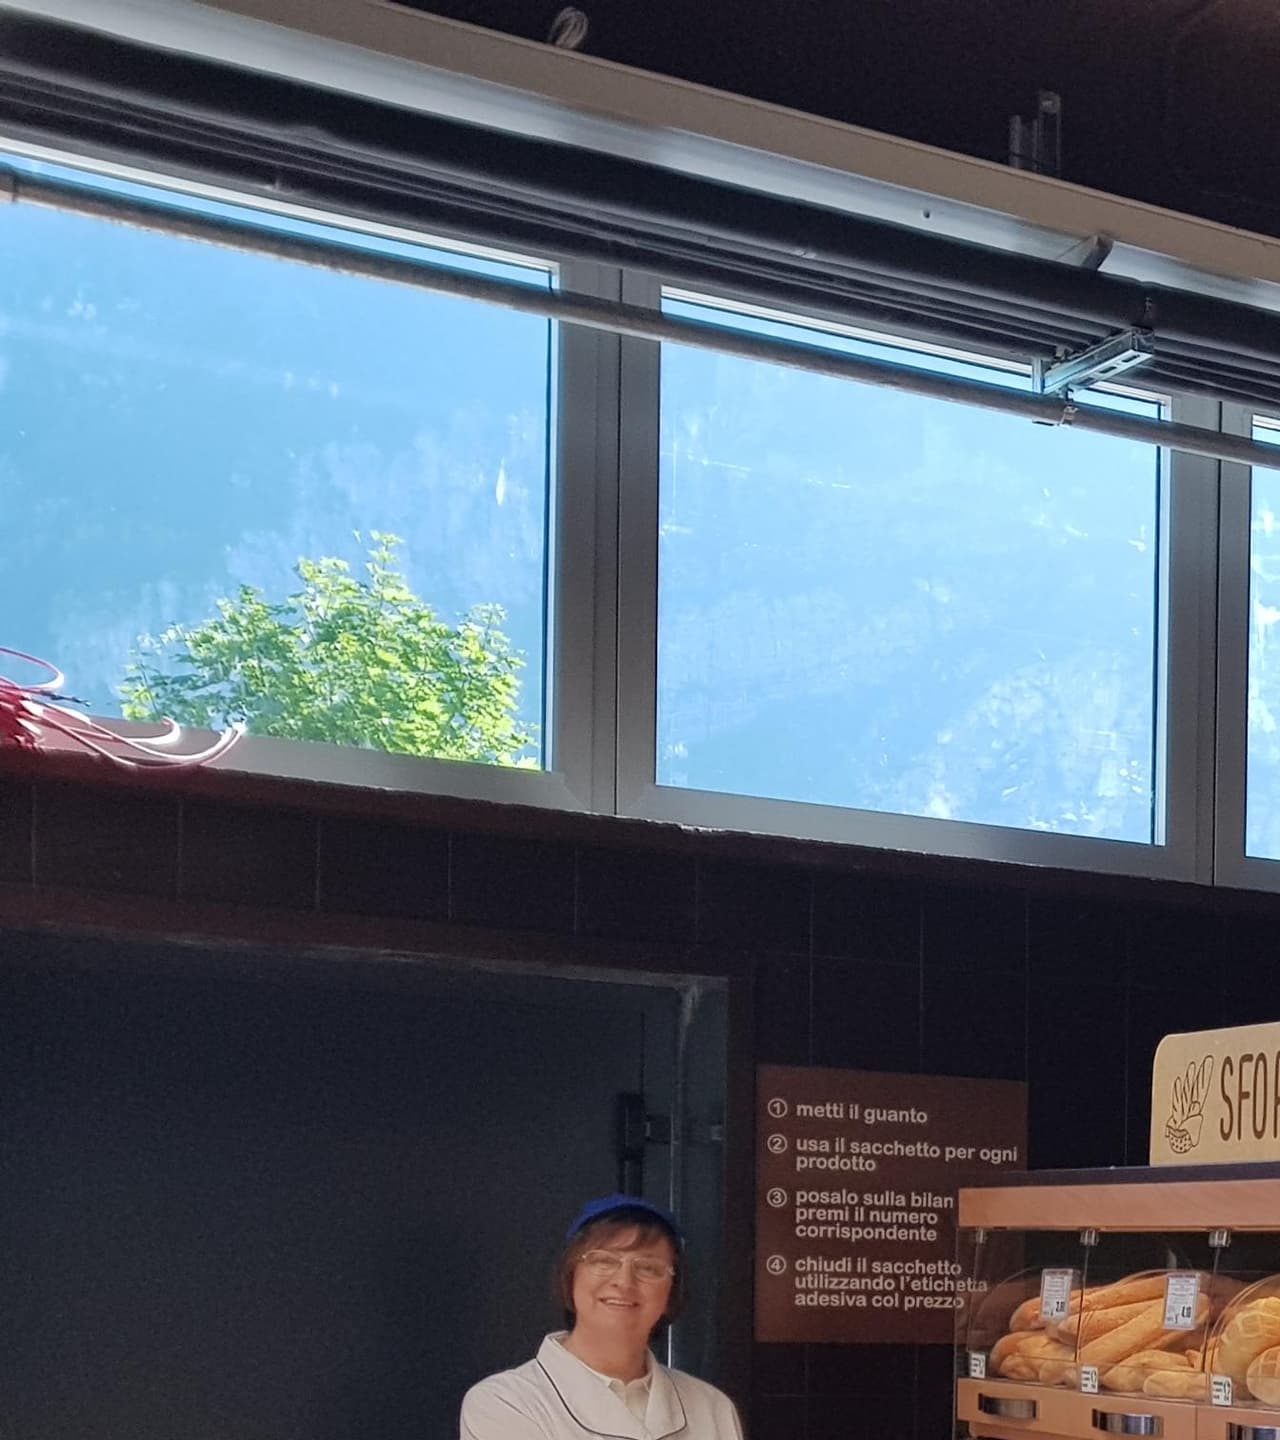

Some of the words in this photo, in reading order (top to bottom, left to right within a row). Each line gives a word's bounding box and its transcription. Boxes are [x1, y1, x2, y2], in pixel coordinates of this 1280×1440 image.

[797, 1102, 843, 1118] metti
[849, 1104, 859, 1119] il
[864, 1107, 928, 1124] guanto
[796, 1138, 829, 1152] usa
[835, 1138, 845, 1152] il
[850, 1141, 940, 1158] sacchetto
[945, 1147, 975, 1162] per
[980, 1147, 1018, 1164] ogni
[796, 1155, 876, 1171] prodotto
[796, 1189, 858, 1206] posalo
[863, 1191, 906, 1206] sulla
[911, 1193, 954, 1208] bilan
[796, 1206, 849, 1223] premi
[854, 1207, 864, 1222] il
[869, 1210, 938, 1225] numero
[796, 1223, 937, 1242] corrispondente
[795, 1257, 851, 1272] chiudi
[856, 1258, 867, 1273] il
[872, 1259, 962, 1275] sacchetto
[795, 1275, 895, 1290] utilizzando
[795, 1292, 867, 1307] adesiva
[871, 1293, 899, 1308] col
[904, 1295, 965, 1311] prezzo
